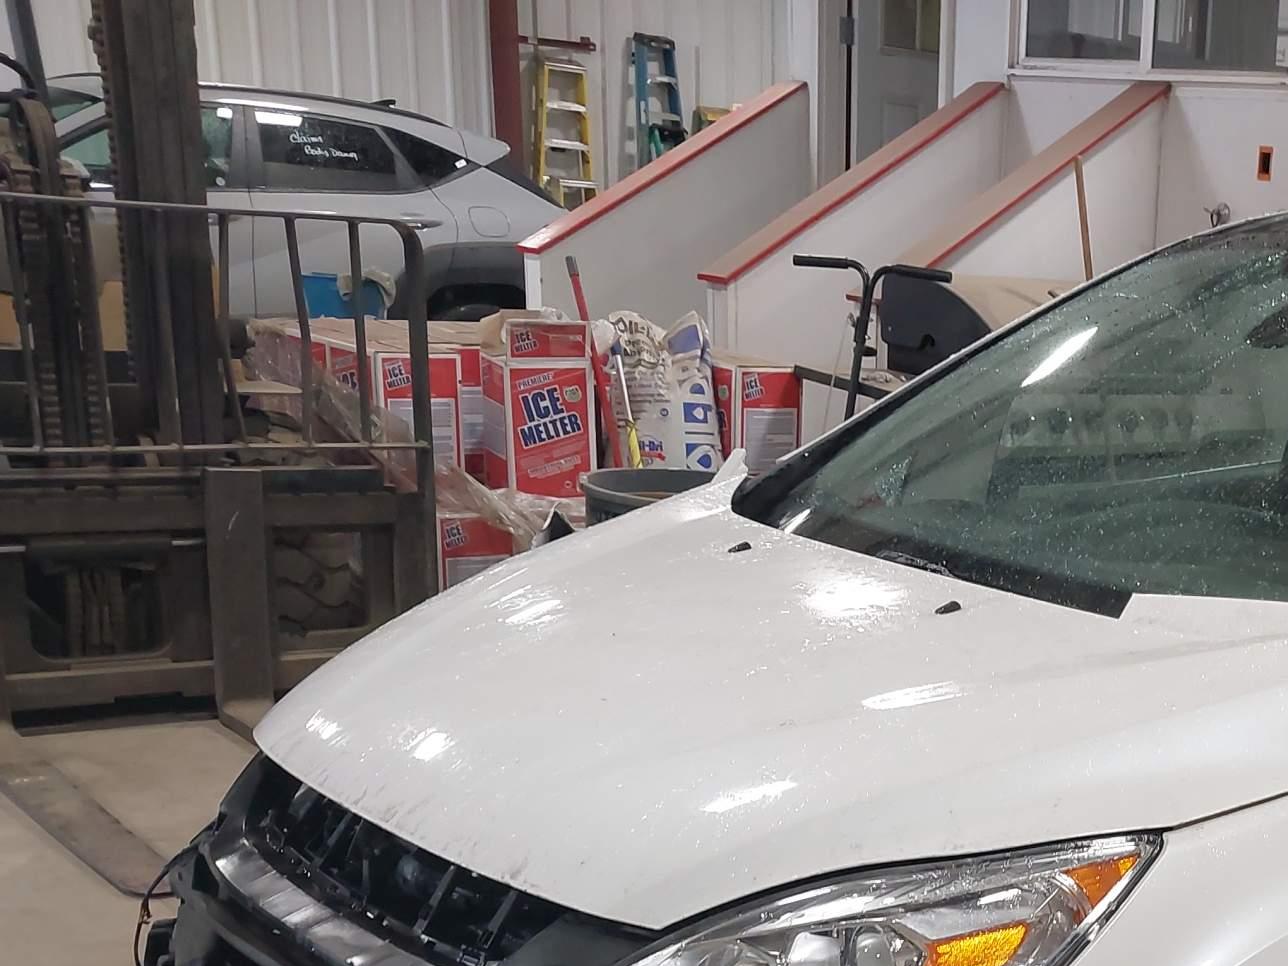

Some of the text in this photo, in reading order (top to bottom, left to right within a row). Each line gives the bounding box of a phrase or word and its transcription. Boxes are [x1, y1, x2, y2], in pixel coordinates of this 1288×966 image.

[387, 364, 406, 380] ICE
[520, 386, 566, 423] ICE
[519, 412, 583, 448] MELTER
